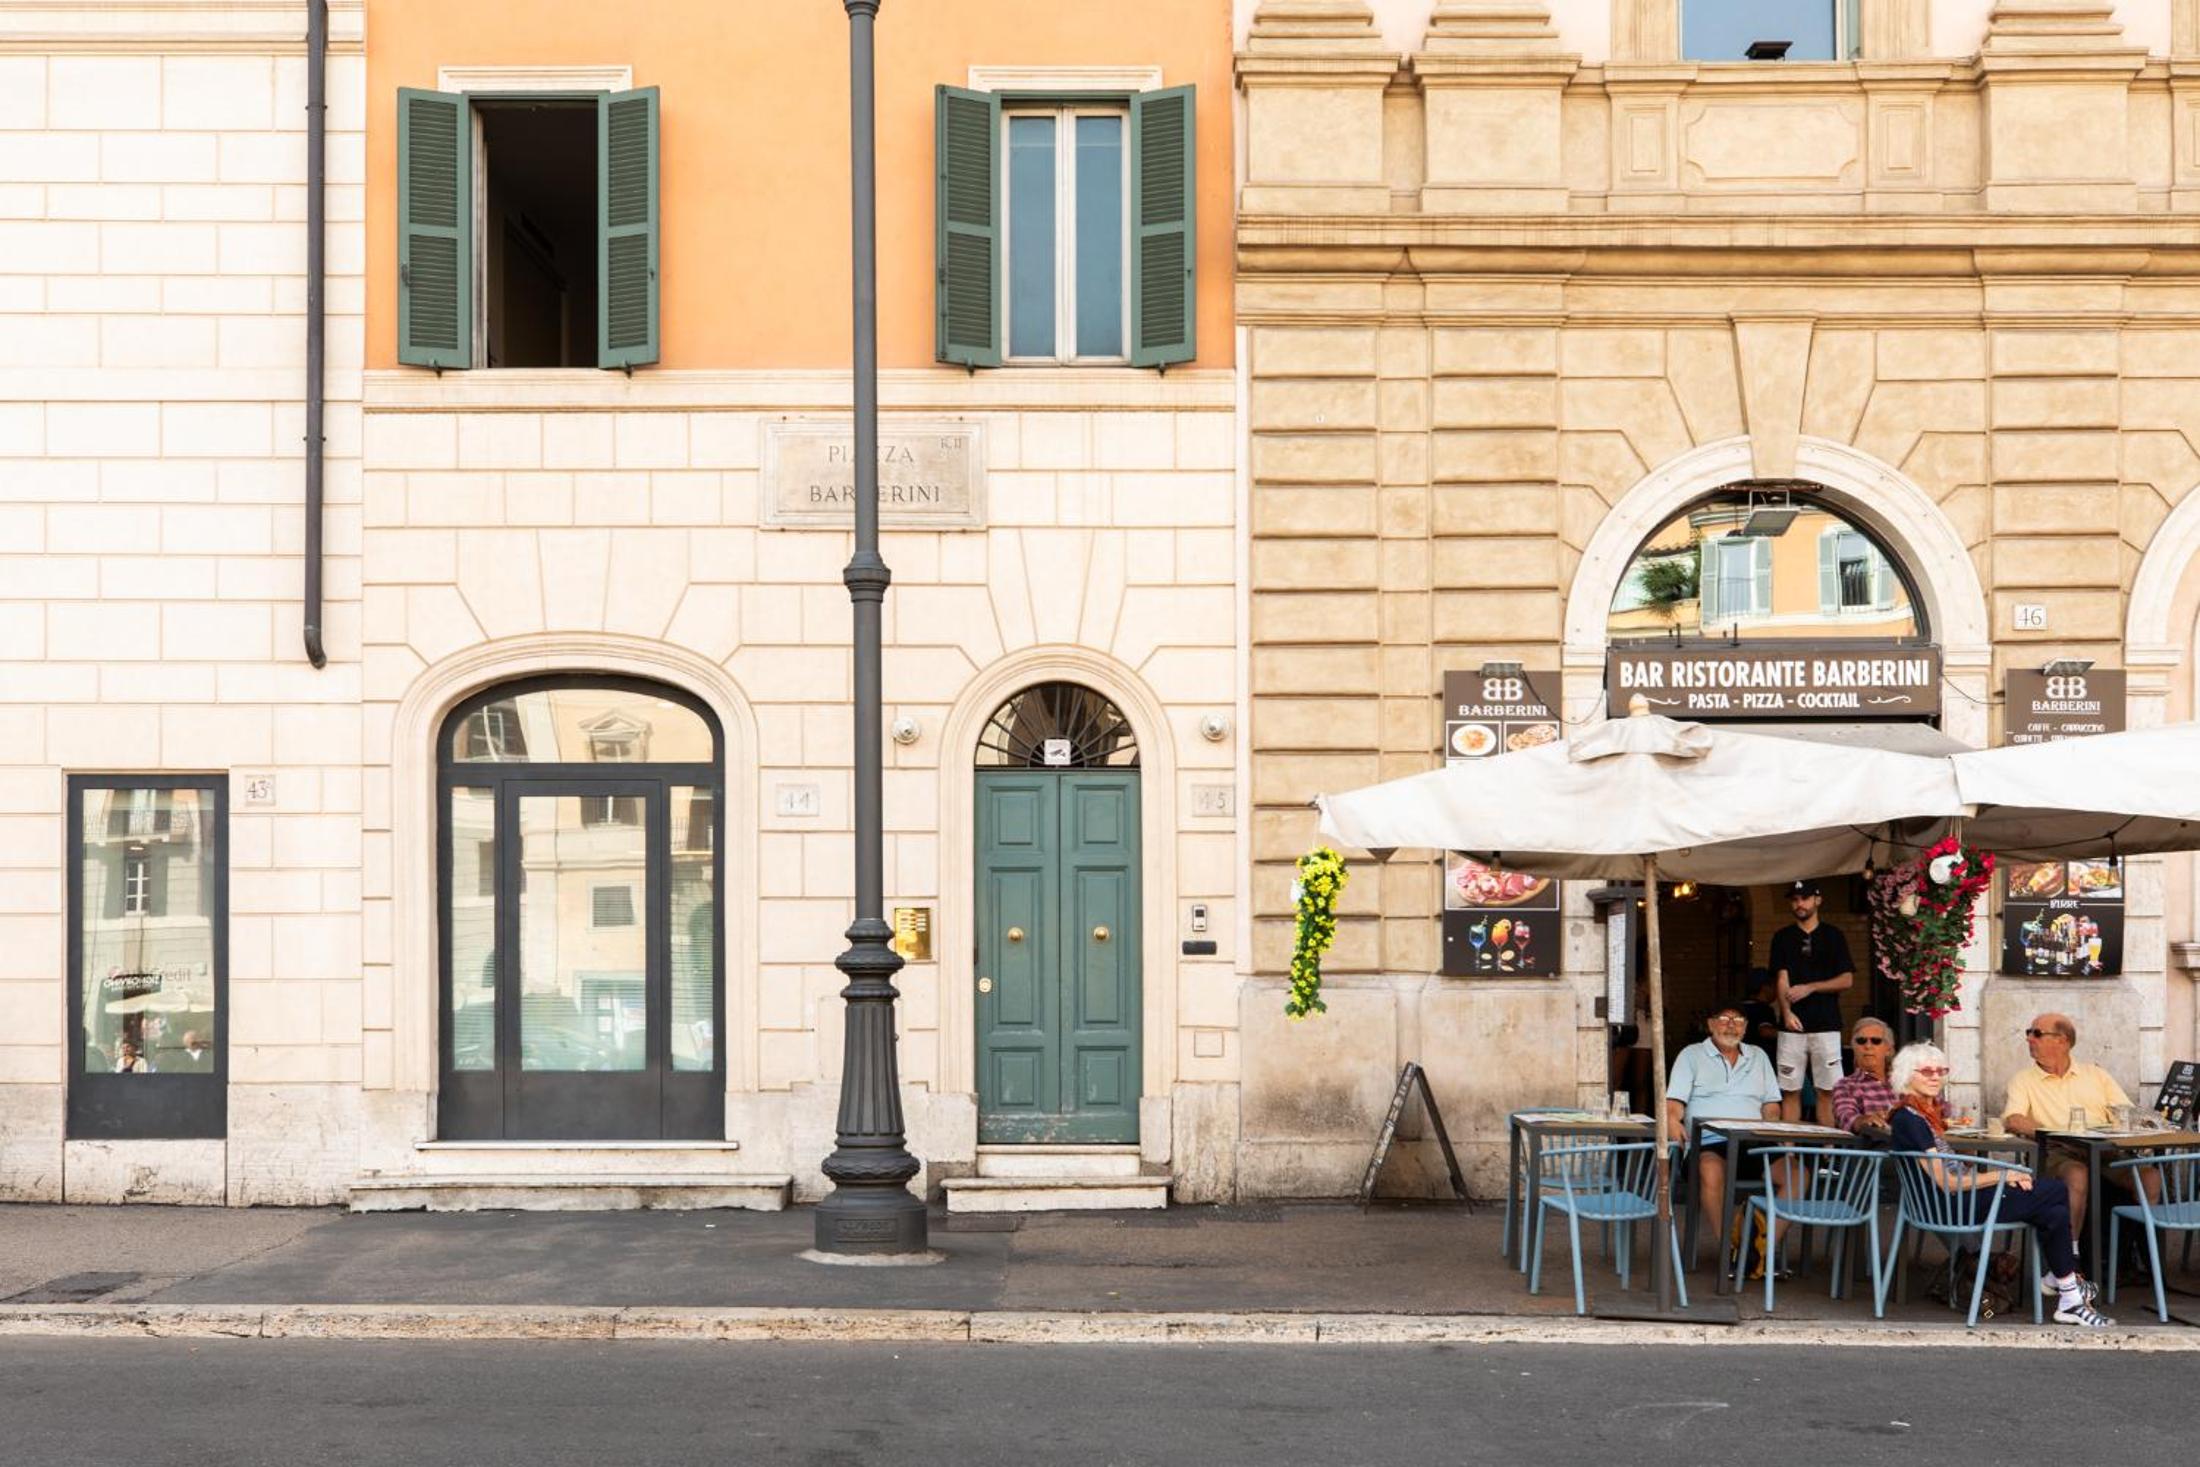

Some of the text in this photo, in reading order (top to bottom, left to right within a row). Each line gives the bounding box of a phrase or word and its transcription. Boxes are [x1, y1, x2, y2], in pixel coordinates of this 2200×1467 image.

[829, 445, 914, 464] PIZA
[810, 485, 940, 502] BARERINI
[2019, 608, 2042, 625] 46
[1620, 659, 1929, 688] BAR RISTORANTE BARBERINI
[1689, 693, 1730, 709] PASTA
[1743, 693, 1784, 709] PIZZA
[1797, 692, 1861, 709] COCKTAIL
[2031, 700, 2101, 711] BARBERINI
[1458, 704, 1548, 717] BARBERINI
